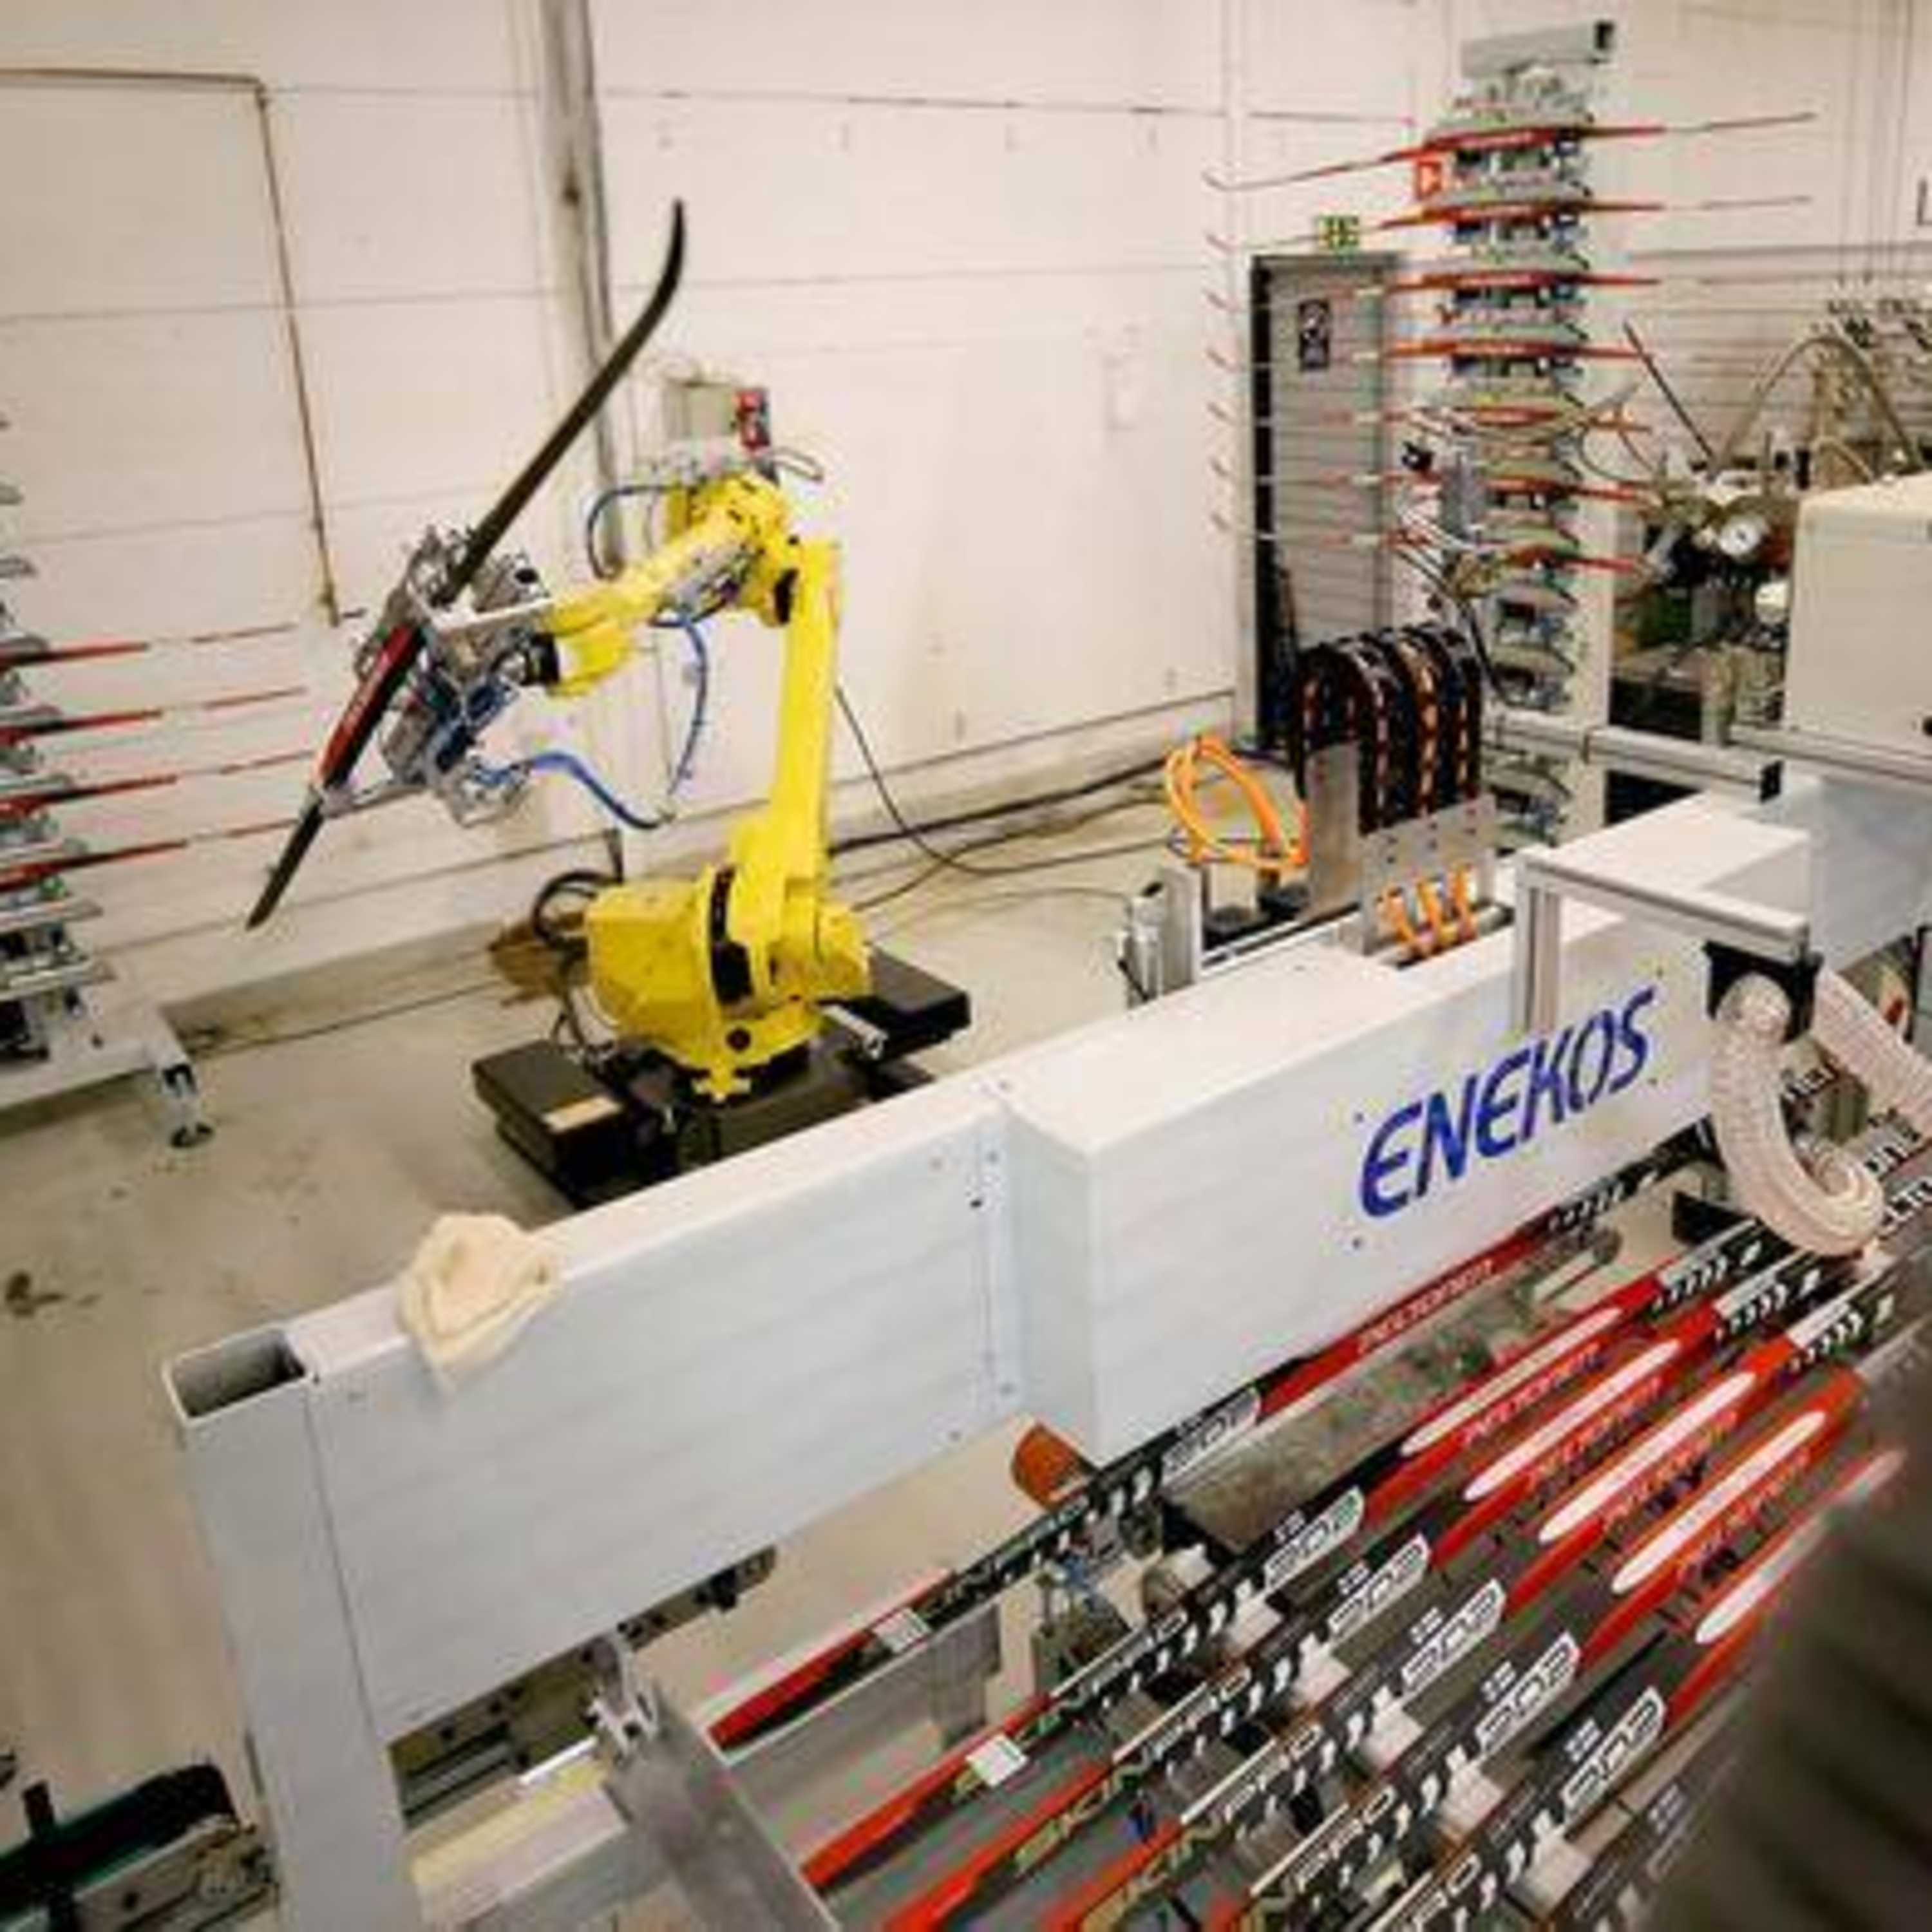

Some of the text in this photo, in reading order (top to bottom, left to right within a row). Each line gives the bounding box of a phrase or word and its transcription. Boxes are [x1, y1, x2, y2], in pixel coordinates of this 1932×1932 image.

[1360, 987, 1656, 1217] ENEKOS
[1154, 1662, 1249, 1760] PRO
[1224, 1721, 1321, 1823] PRO
[1297, 1783, 1396, 1893] PRO
[1406, 1853, 1480, 1932] RO
